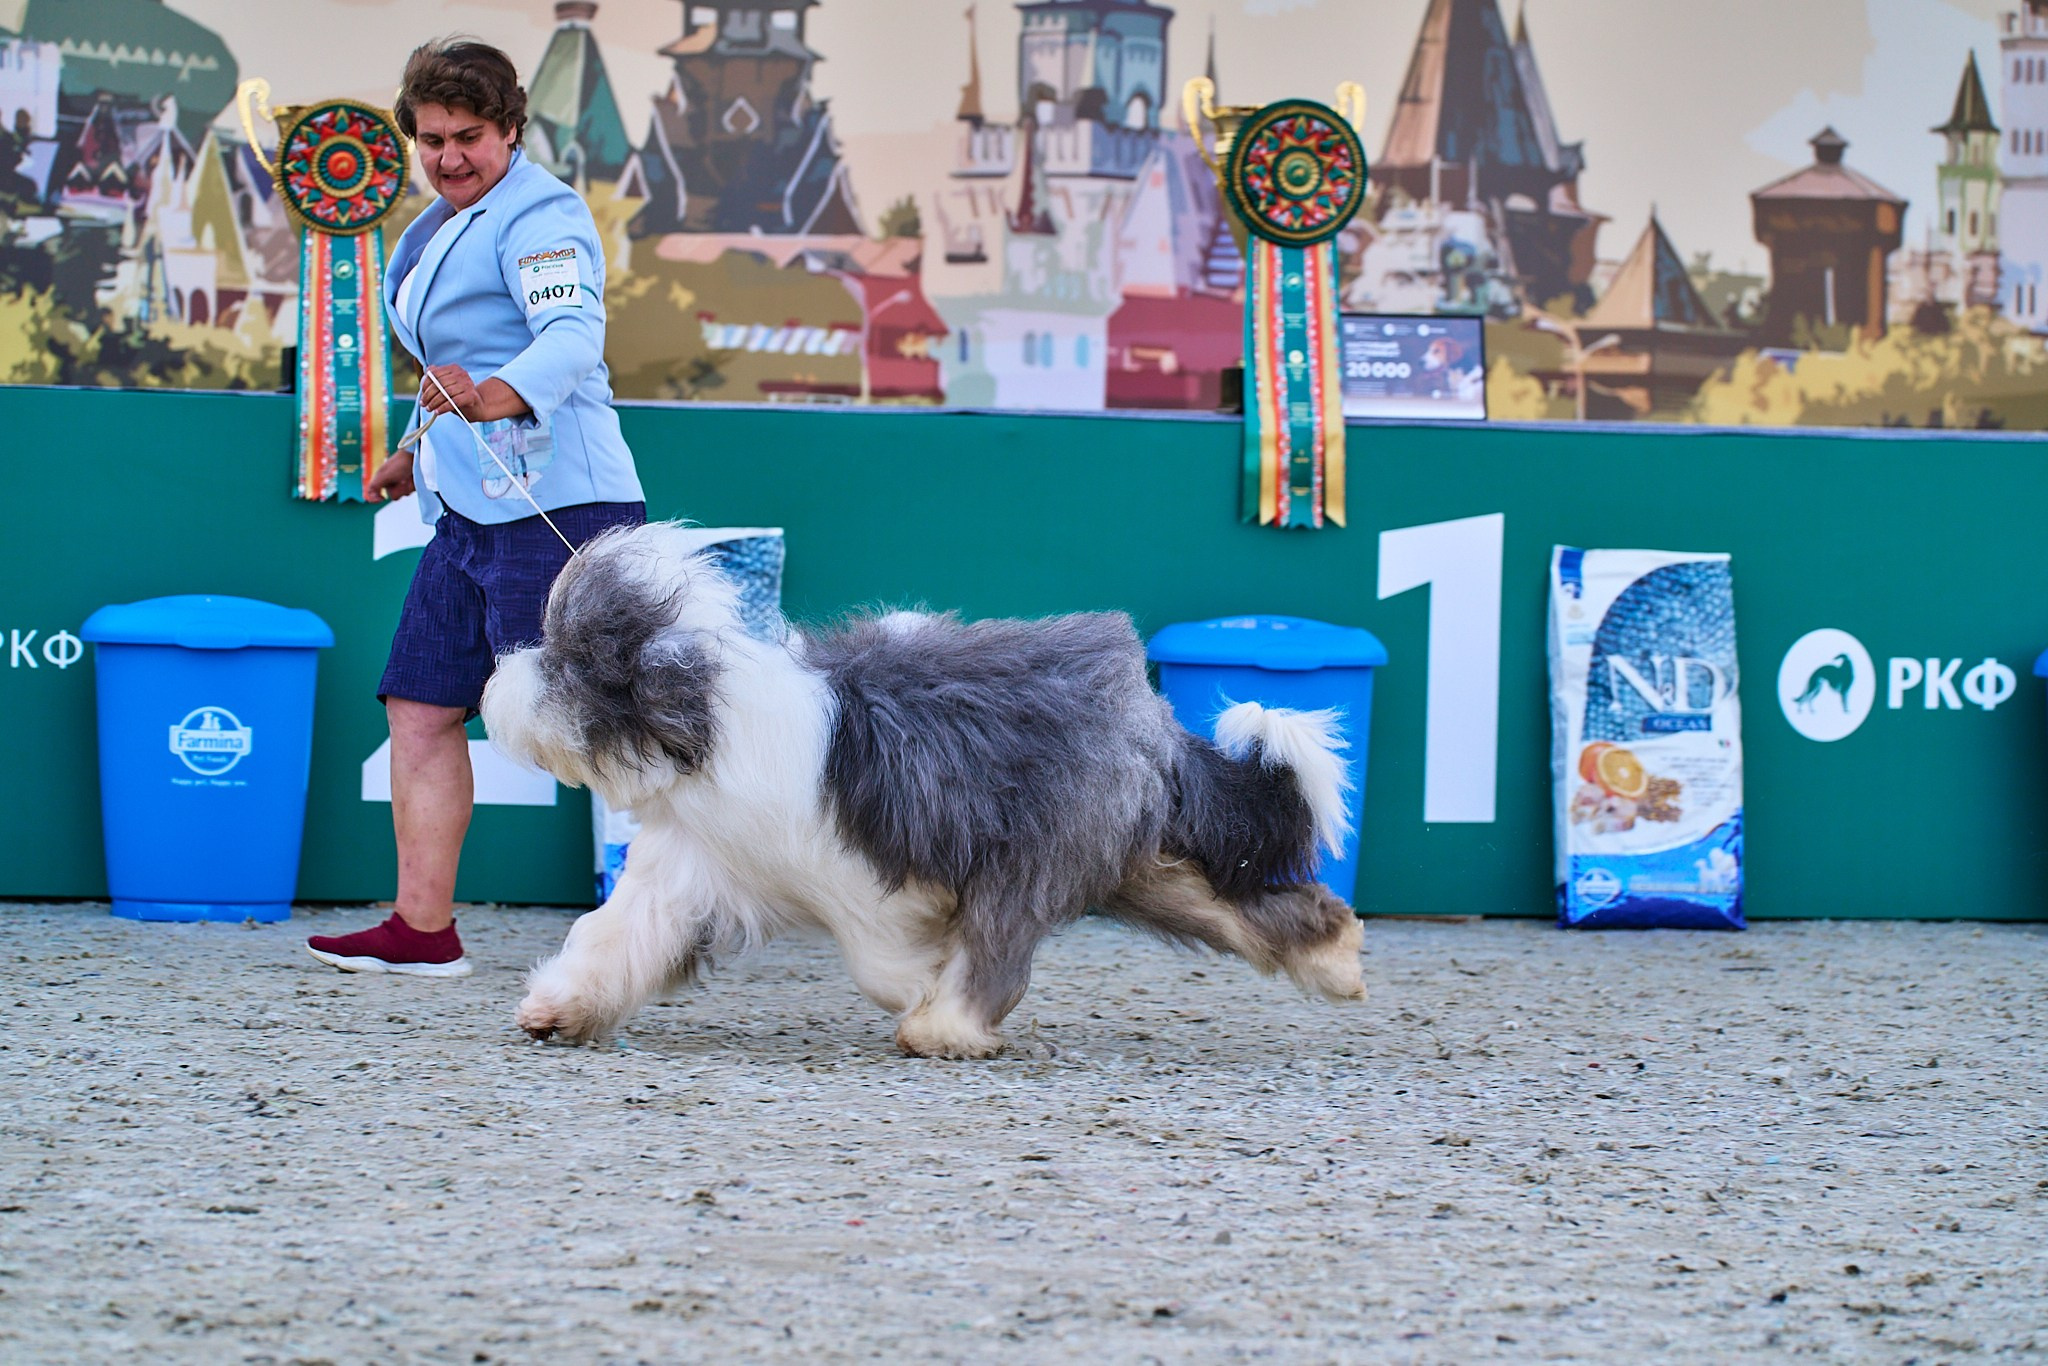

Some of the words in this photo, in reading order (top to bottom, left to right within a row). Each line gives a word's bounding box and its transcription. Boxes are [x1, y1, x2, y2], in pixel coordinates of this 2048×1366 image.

[529, 284, 575, 305] 0407
[1377, 512, 1505, 823] 1
[1888, 657, 2017, 710] РКФ
[178, 731, 244, 749] Farmina
